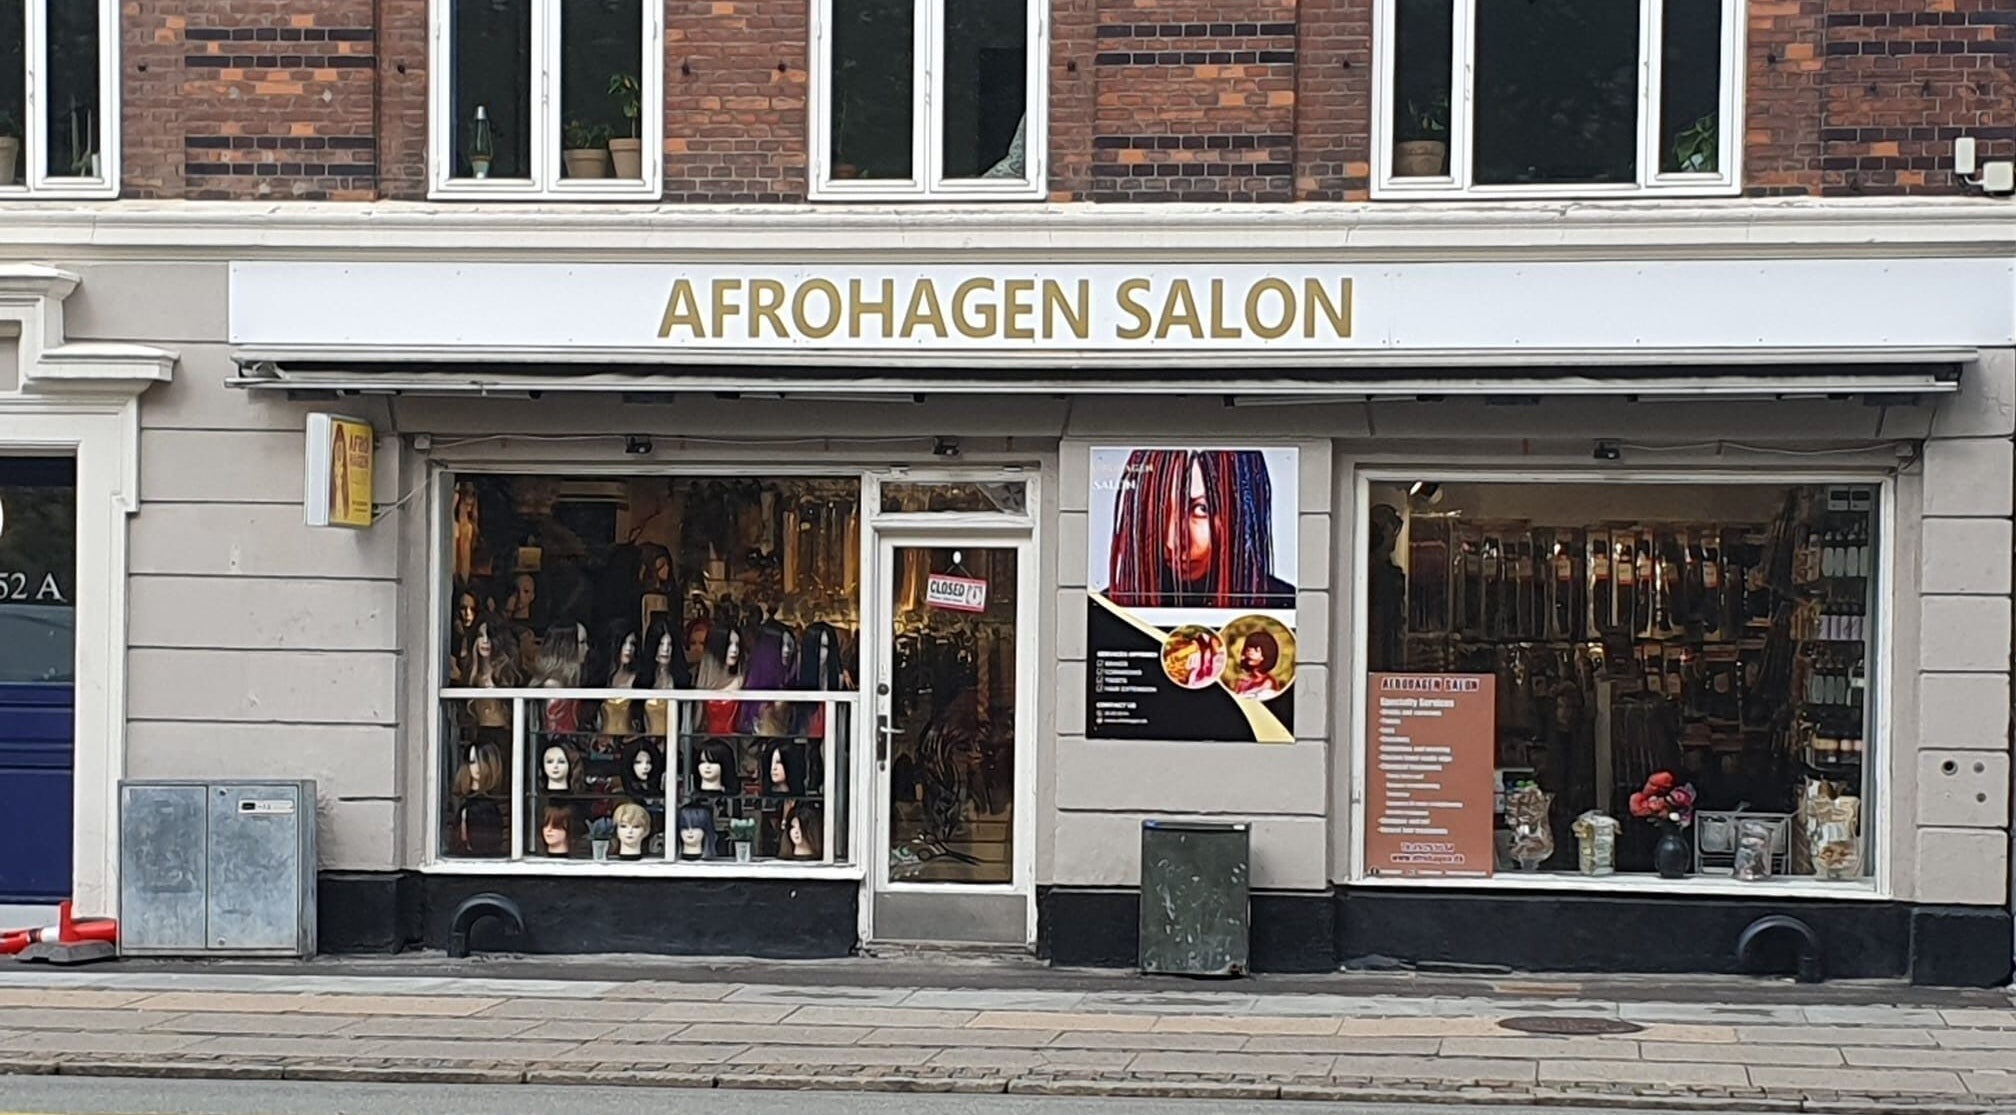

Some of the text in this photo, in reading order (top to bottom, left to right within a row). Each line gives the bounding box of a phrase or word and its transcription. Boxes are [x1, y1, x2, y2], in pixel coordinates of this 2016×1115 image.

[658, 279, 1352, 340] AFROHAGEN SALON
[36, 572, 67, 602] A
[929, 580, 965, 597] CLOSED
